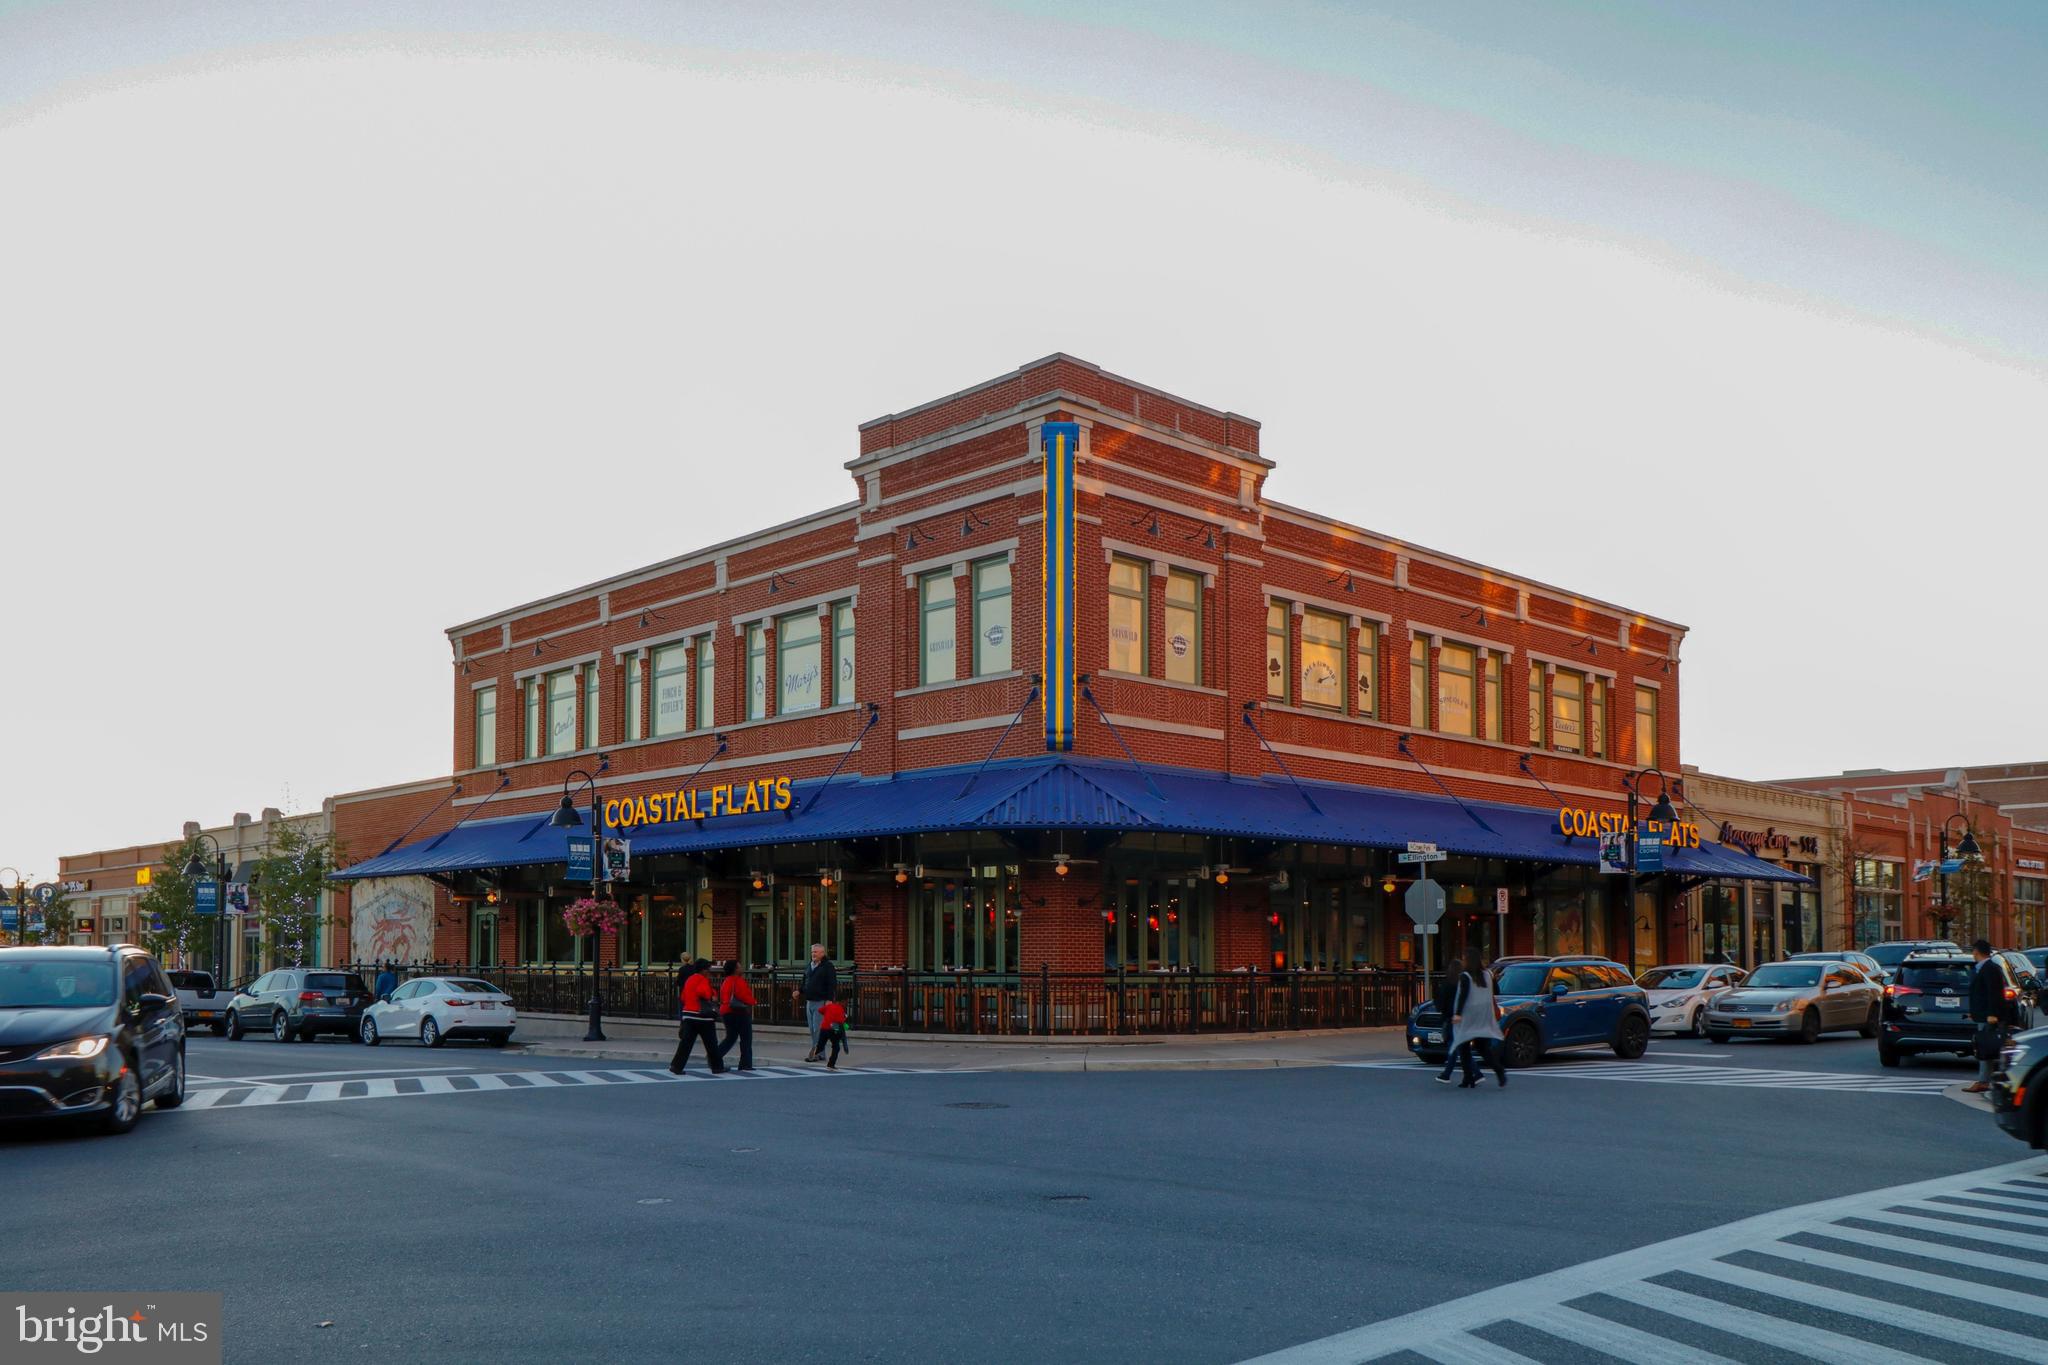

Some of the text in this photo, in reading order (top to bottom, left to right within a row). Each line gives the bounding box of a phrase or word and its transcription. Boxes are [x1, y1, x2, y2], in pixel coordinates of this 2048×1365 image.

[605, 777, 791, 828] COASTAL FLATS
[1407, 852, 1439, 861] Ellington
